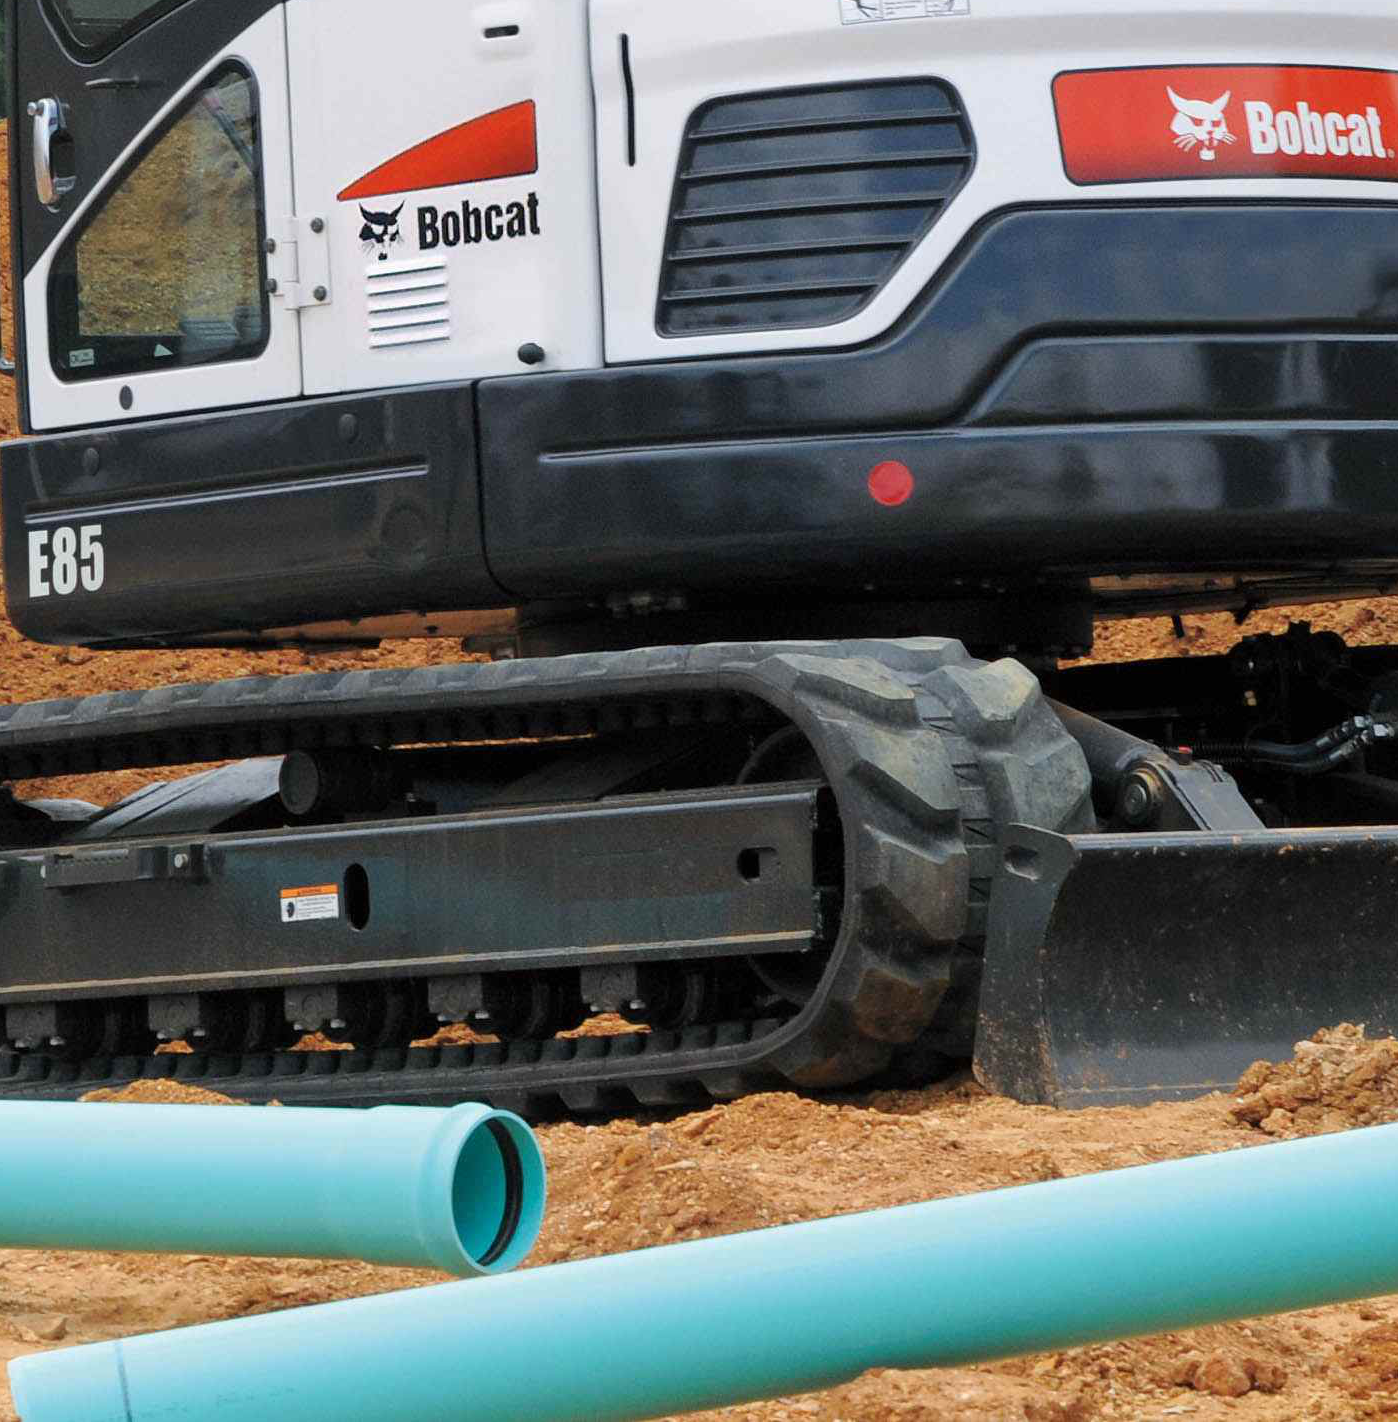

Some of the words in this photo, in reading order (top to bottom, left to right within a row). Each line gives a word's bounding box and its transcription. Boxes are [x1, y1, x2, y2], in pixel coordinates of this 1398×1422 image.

[1244, 101, 1387, 158] Bobcat
[417, 192, 540, 250] Bobcat
[28, 524, 104, 598] E85
